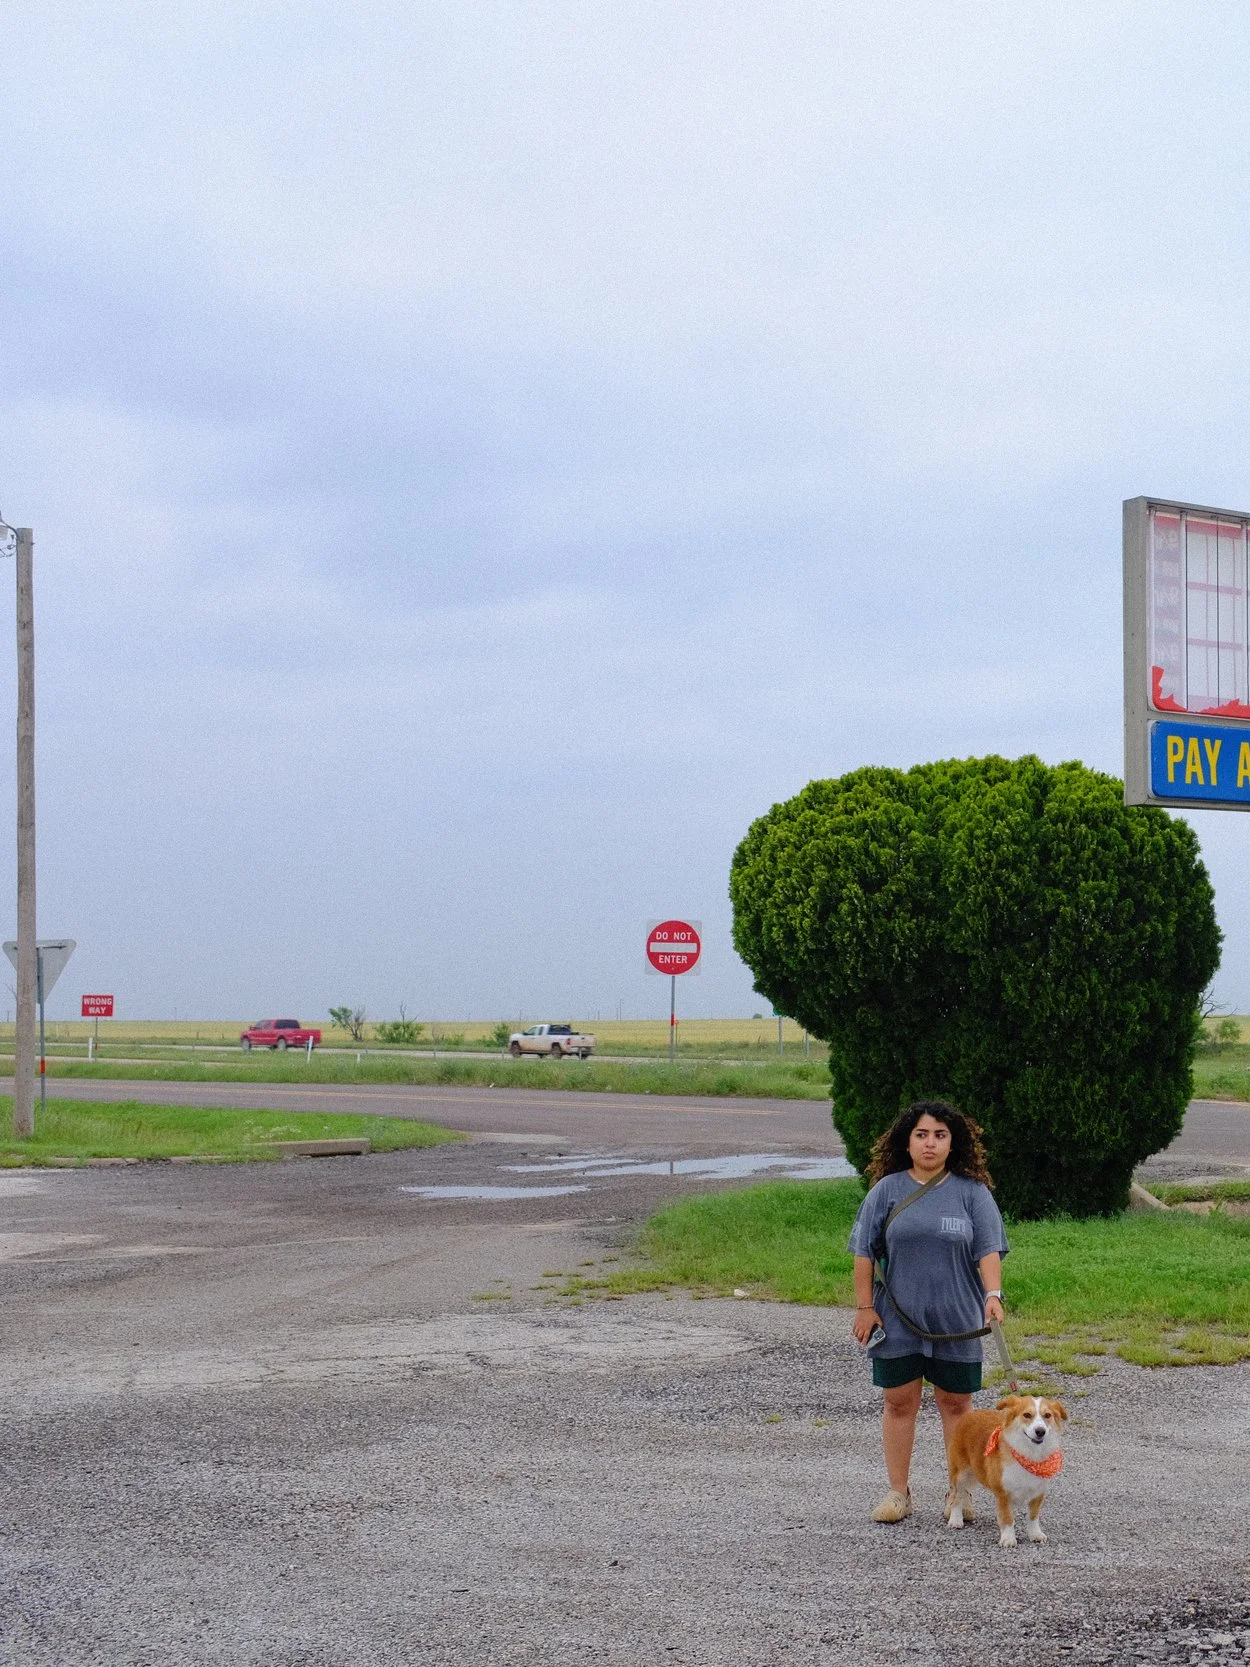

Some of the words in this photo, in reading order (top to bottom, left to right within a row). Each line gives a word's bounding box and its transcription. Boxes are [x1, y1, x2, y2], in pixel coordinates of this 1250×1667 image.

[1167, 735, 1222, 786] PAY
[655, 931, 669, 940] DO
[673, 932, 692, 941] NOT
[658, 954, 688, 964] ENTER
[83, 997, 112, 1005] WRONG
[89, 1006, 106, 1014] WAY
